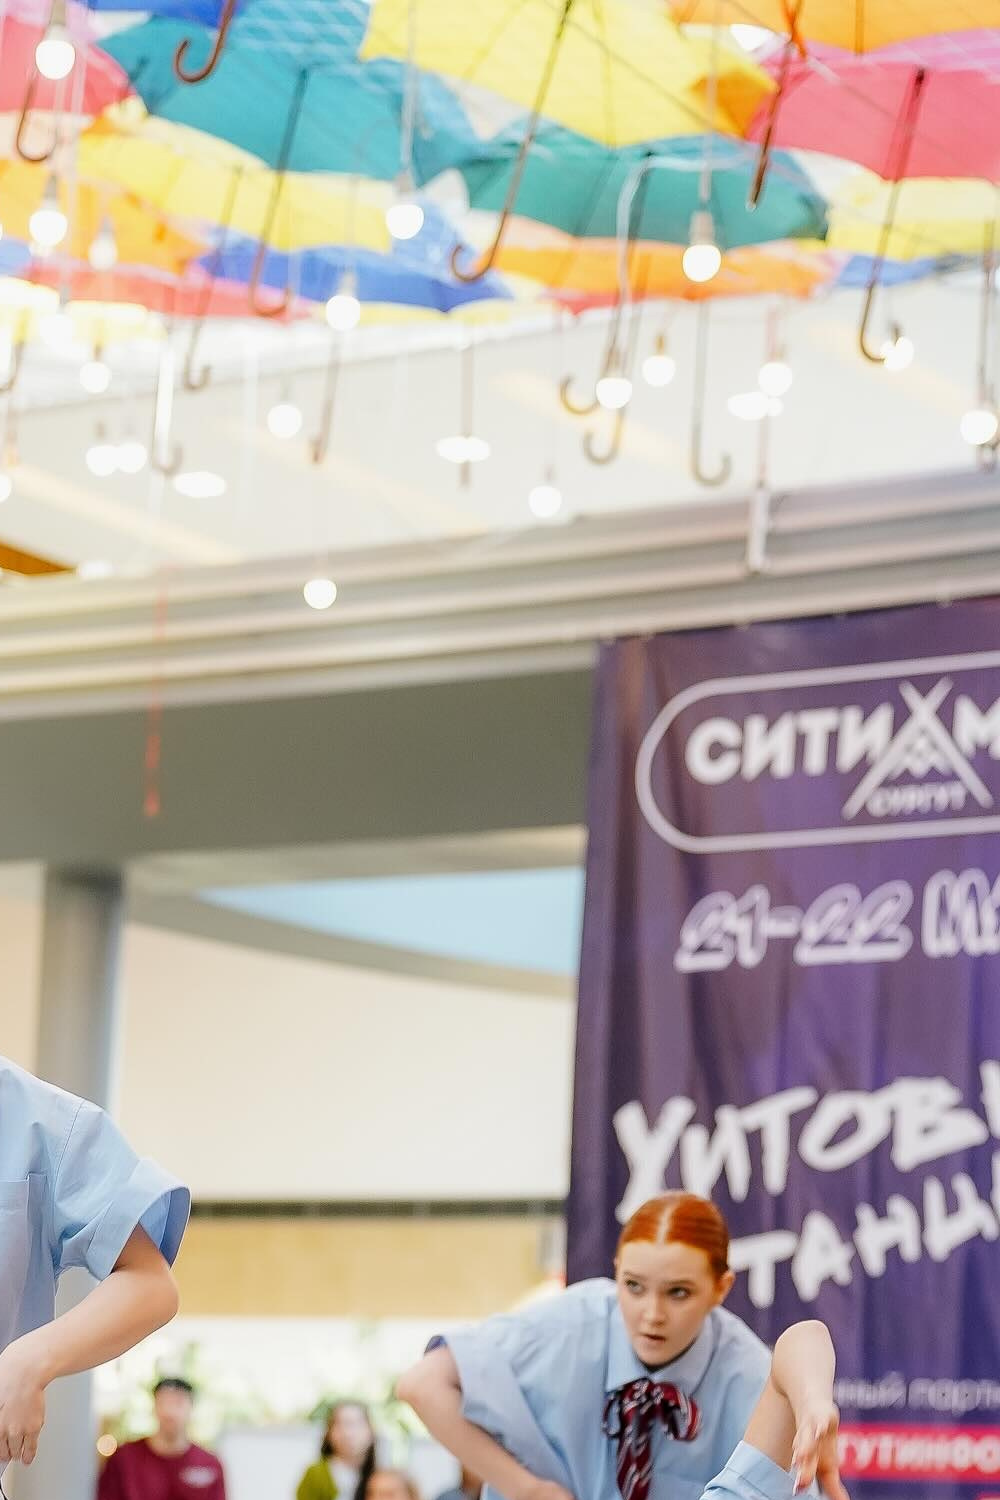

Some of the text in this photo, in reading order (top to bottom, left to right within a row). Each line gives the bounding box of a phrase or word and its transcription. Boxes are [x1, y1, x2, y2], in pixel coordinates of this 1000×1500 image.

[685, 702, 894, 785] СИТИ
[673, 878, 914, 974] 21-22
[729, 1150, 1000, 1311] ТАНЦ
[837, 1431, 1000, 1473] ГУТИНФО
